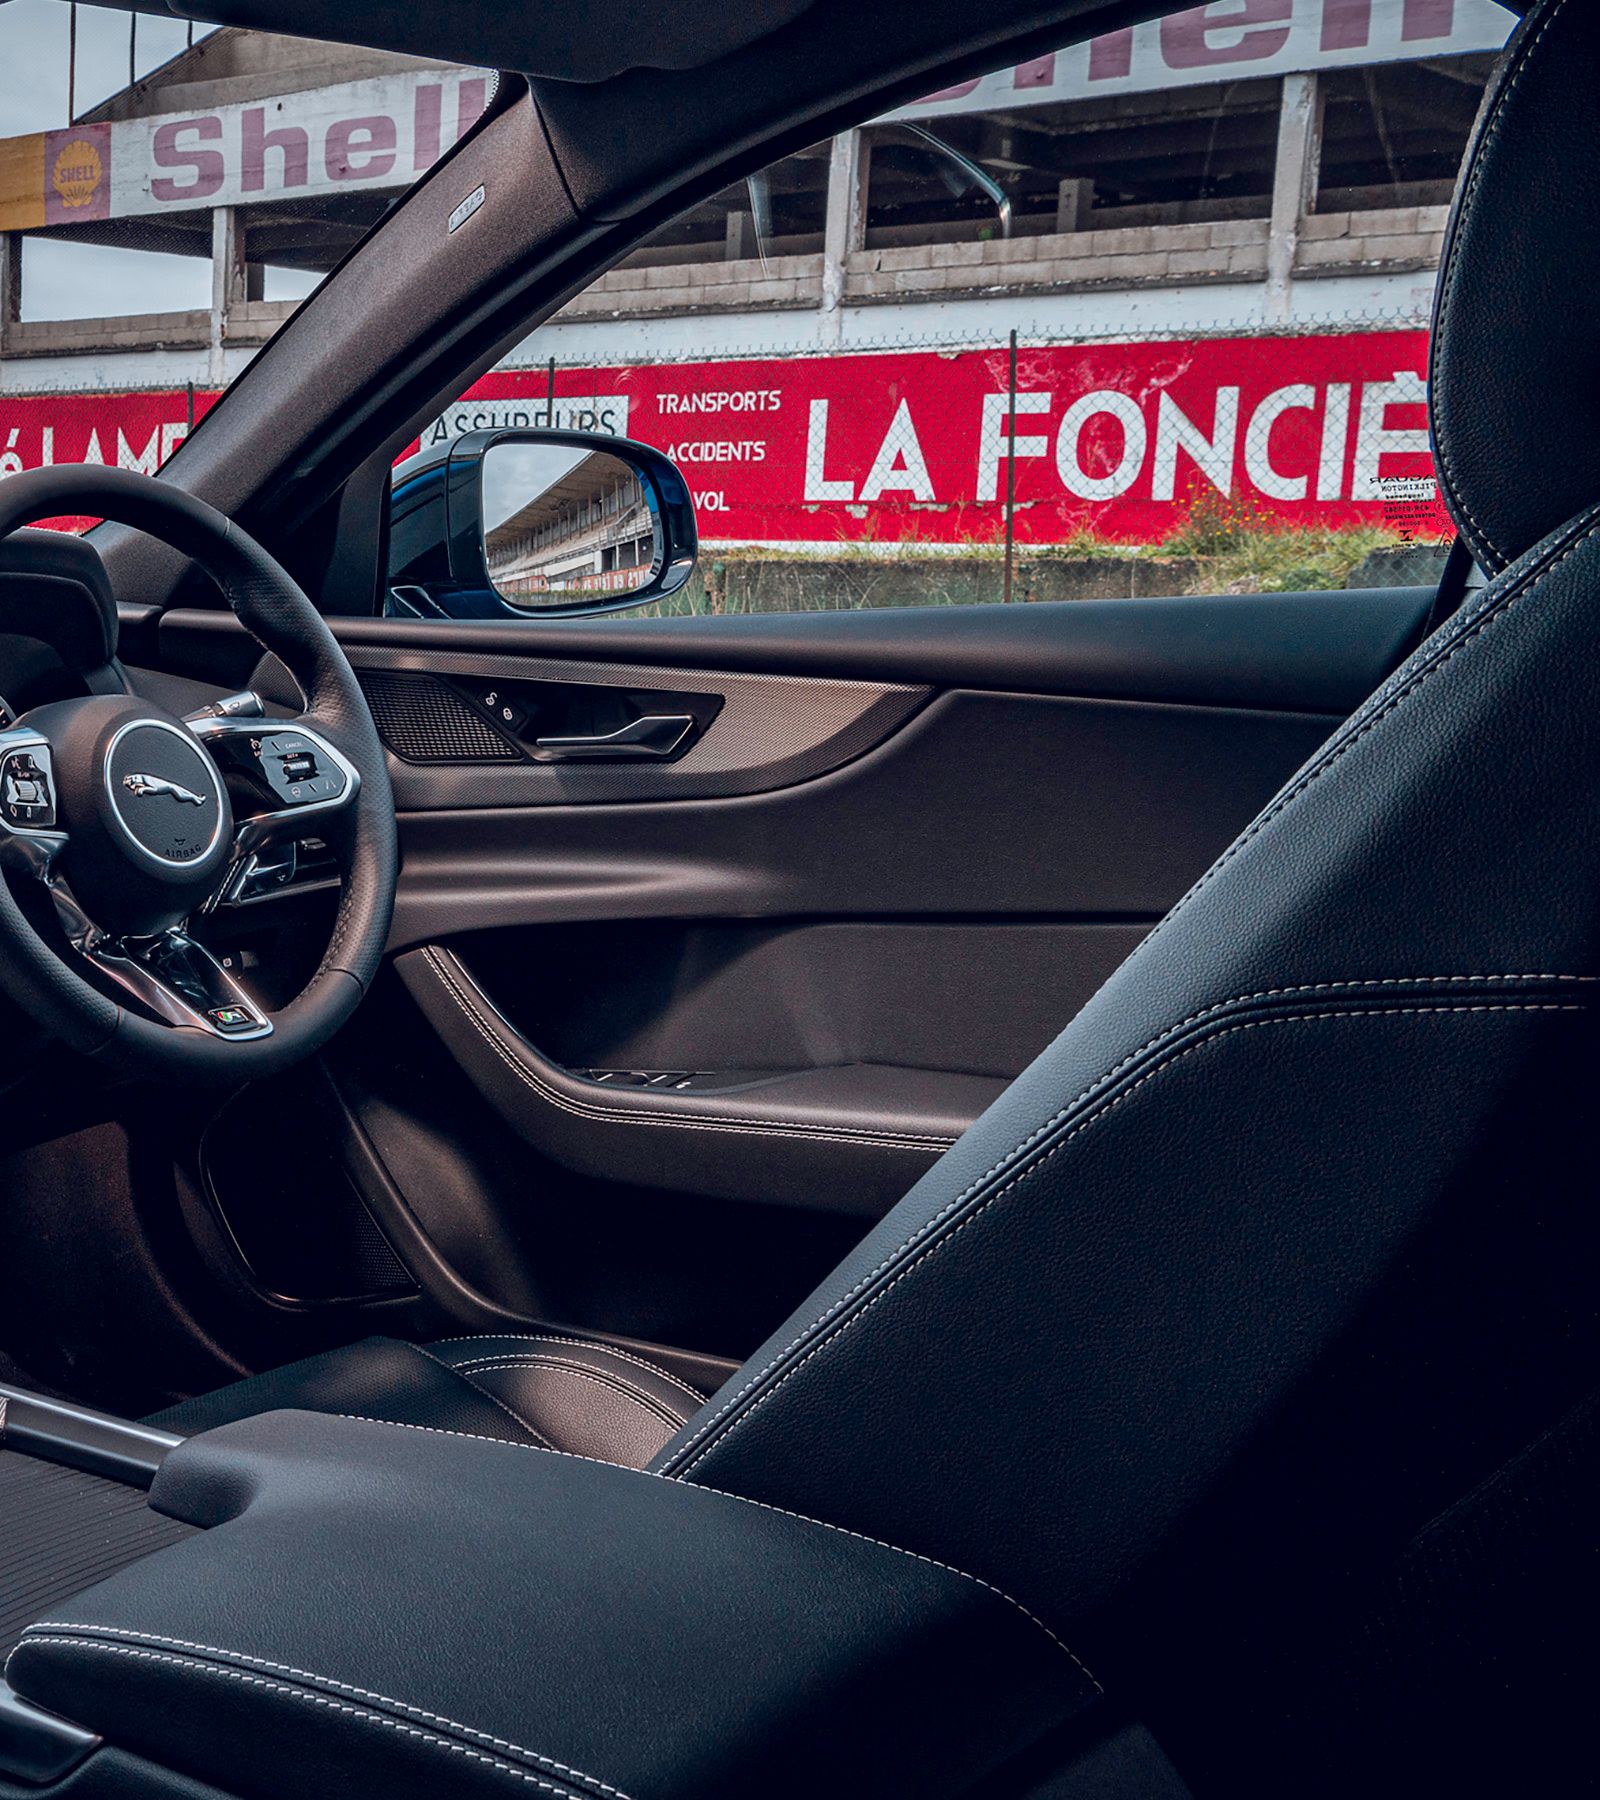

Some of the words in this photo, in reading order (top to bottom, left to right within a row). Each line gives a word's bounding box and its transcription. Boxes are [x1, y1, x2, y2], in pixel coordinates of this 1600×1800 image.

[60, 162, 97, 184] SHELL
[656, 390, 782, 415] TRANSPORTS
[667, 440, 766, 463] ACCIDENTS
[803, 398, 935, 502] LA
[694, 491, 730, 512] VOL
[165, 843, 202, 858] AIRBAG
